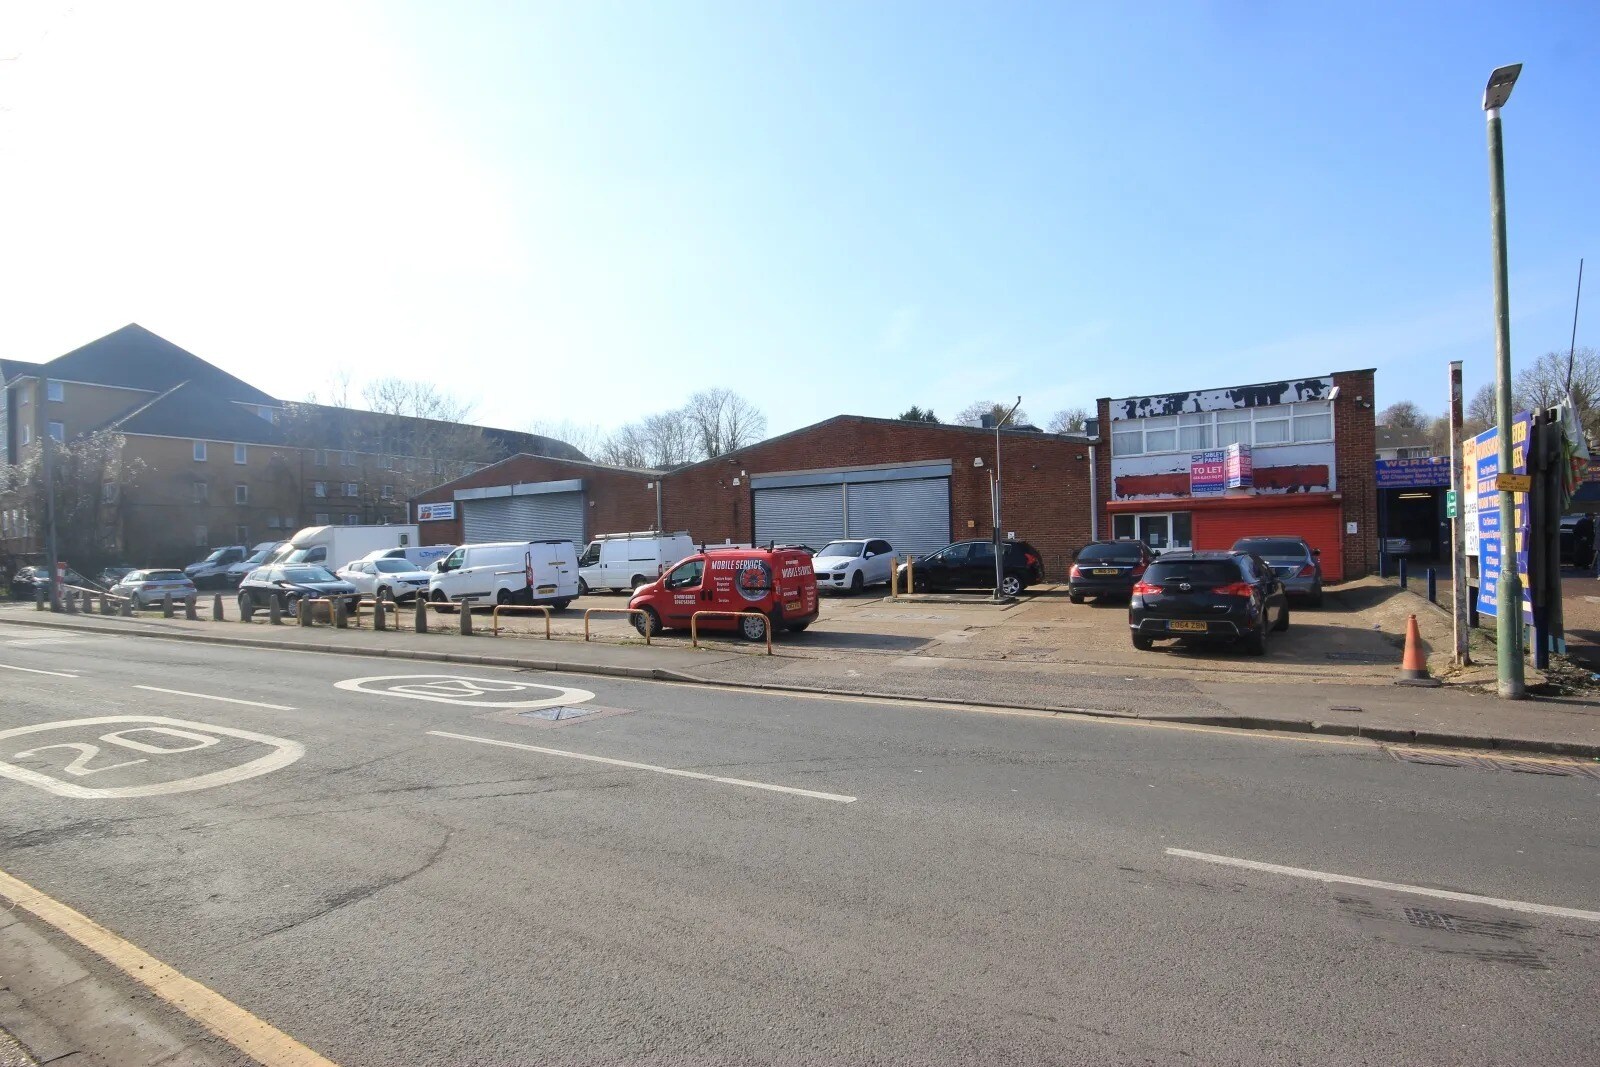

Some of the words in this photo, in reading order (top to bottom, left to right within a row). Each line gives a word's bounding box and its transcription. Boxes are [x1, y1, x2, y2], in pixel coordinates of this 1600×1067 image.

[1385, 457, 1452, 467] WORKSH
[1207, 465, 1222, 473] LET
[711, 560, 734, 570] MOBILE
[735, 559, 763, 570] SERVICE
[781, 566, 798, 578] MOBILE
[798, 565, 812, 576] SERVICE
[14, 726, 220, 776] 20
